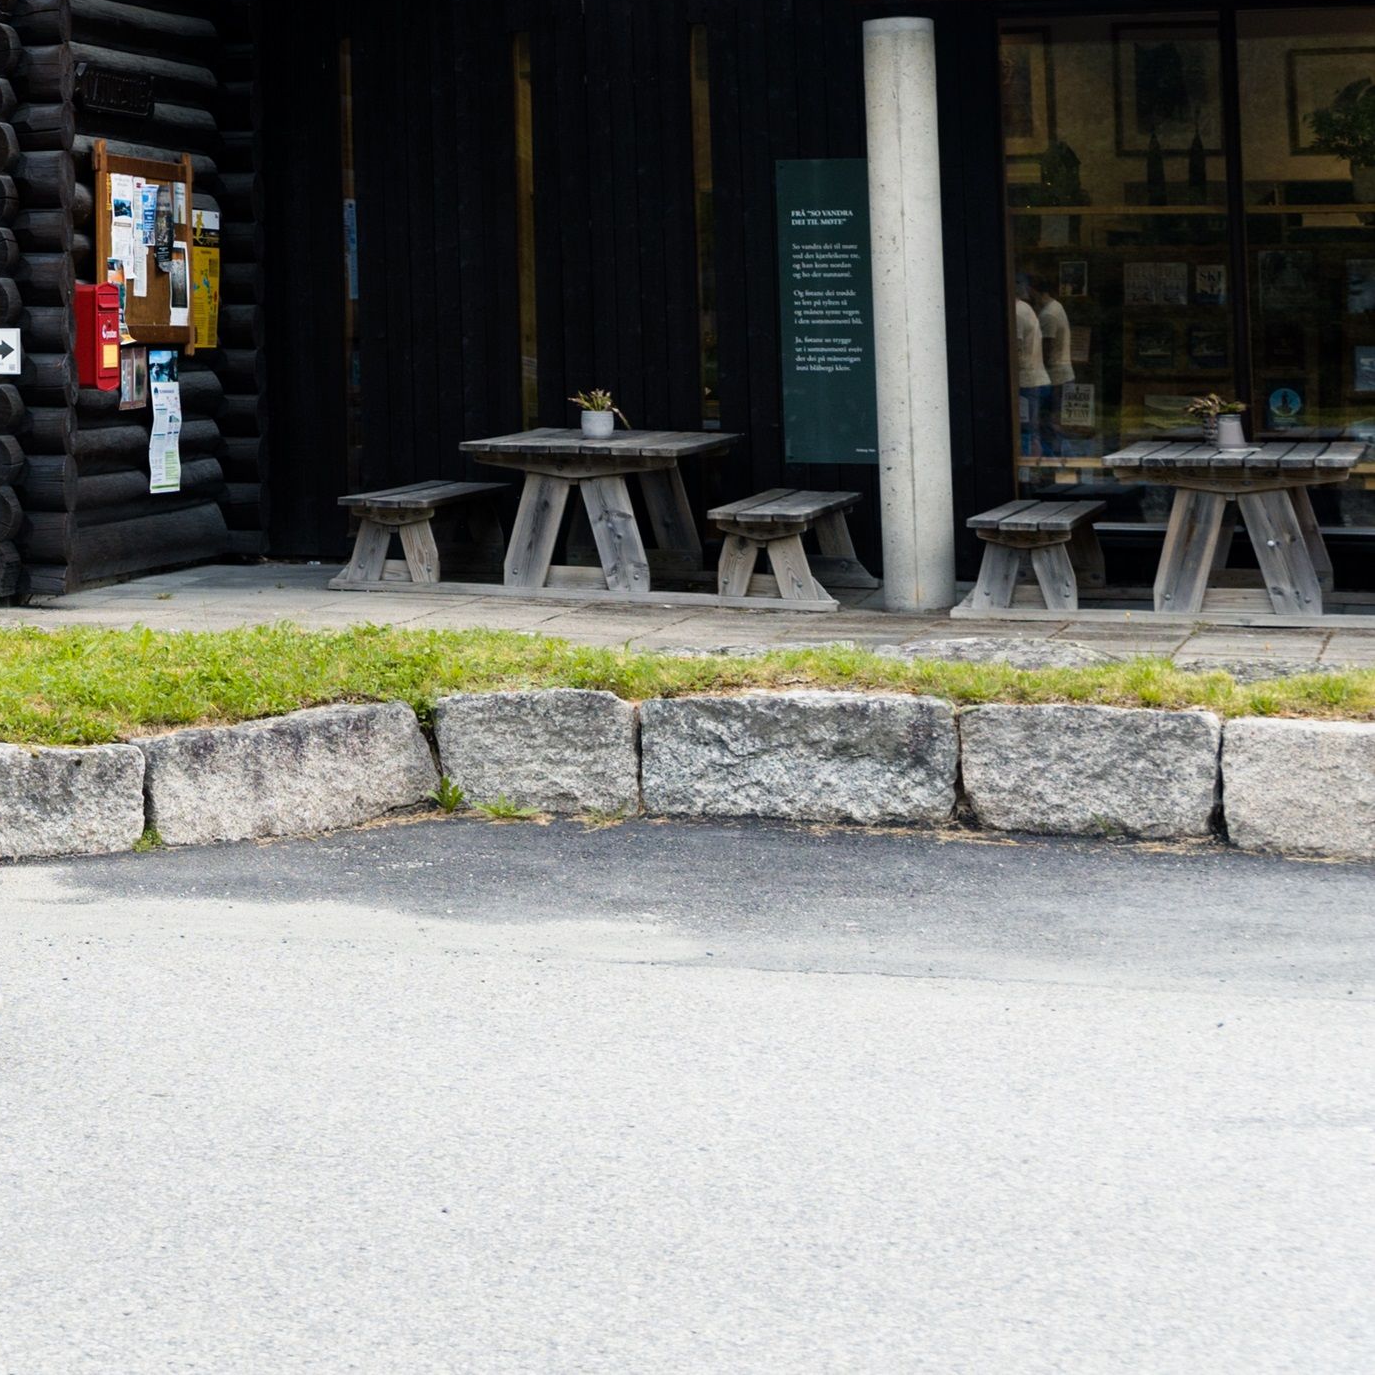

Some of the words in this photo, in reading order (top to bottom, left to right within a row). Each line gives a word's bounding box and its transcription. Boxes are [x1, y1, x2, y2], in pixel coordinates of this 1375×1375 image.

[791, 209, 806, 217] FRÅ
[821, 209, 854, 217] VANDRA
[791, 218, 806, 226] DEI
[806, 218, 819, 226] TIL
